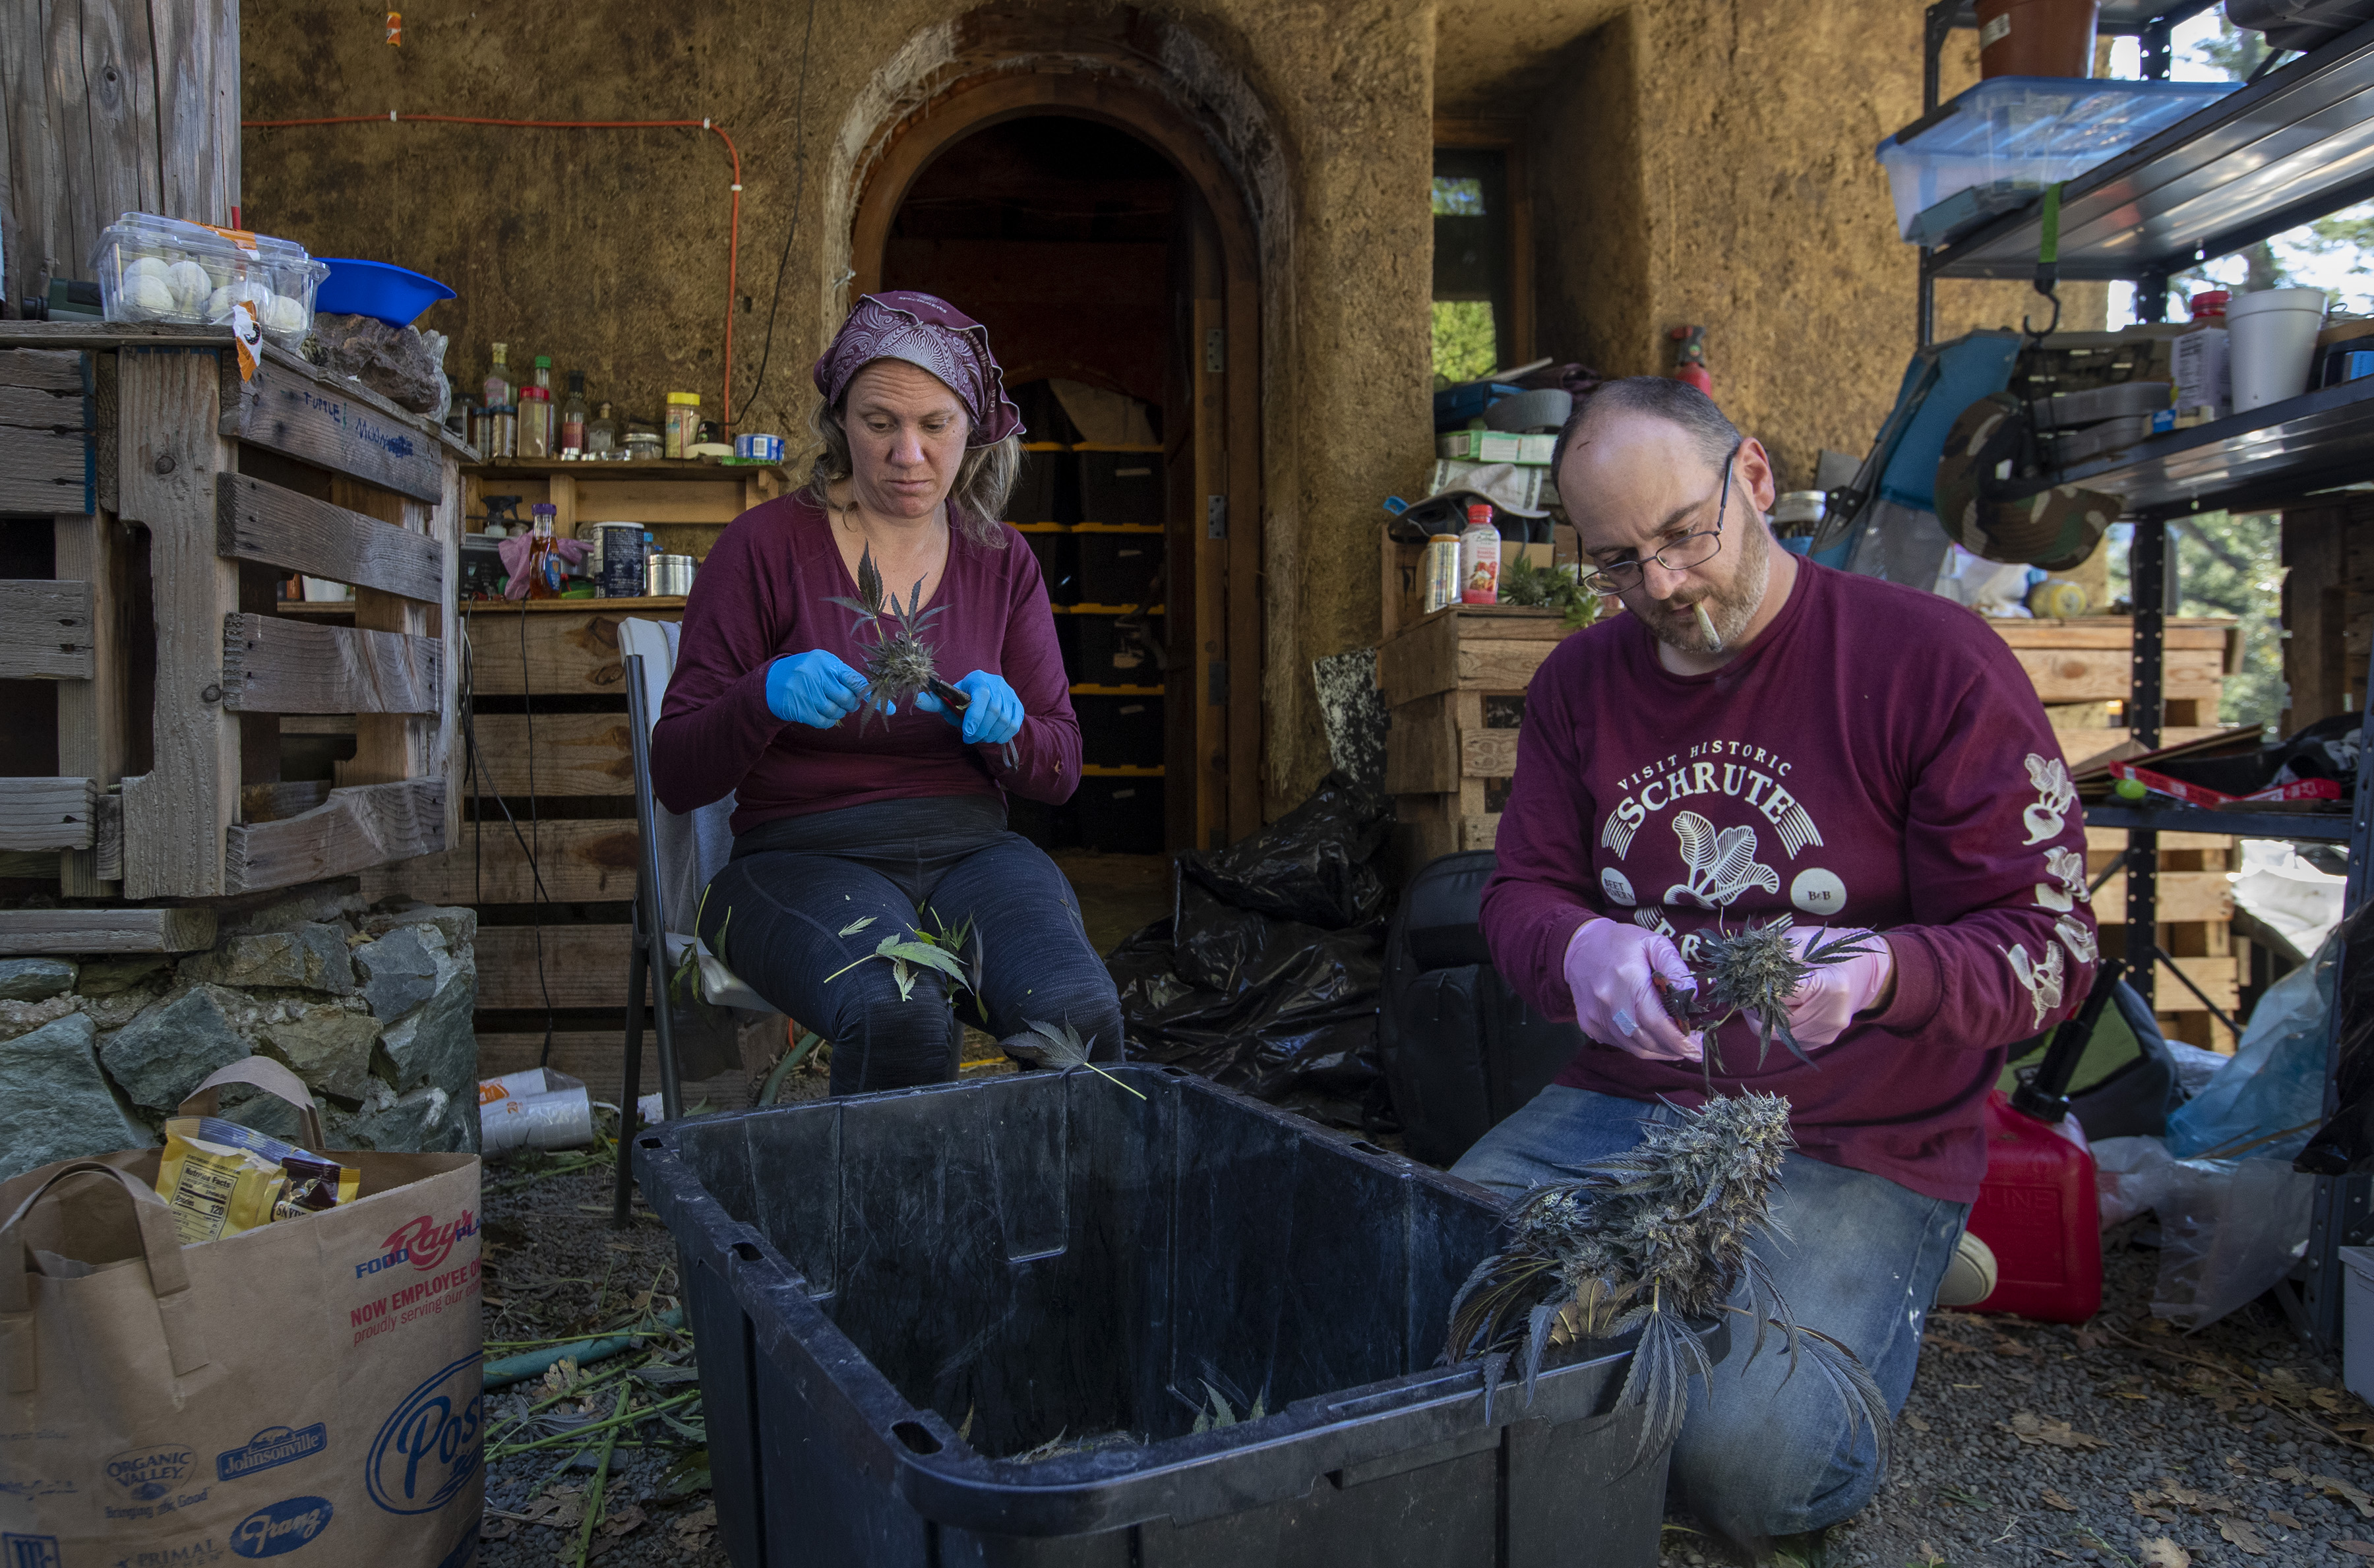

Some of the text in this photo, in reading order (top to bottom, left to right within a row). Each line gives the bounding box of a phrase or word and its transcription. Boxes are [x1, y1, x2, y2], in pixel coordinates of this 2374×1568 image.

[1618, 739, 1792, 791] VISIT HISTORIC
[1617, 762, 1796, 831] SCHRUTE
[1604, 878, 1624, 891] BEET
[185, 1166, 231, 1188] Nutrition Facts
[210, 1204, 225, 1216] 120
[379, 1209, 474, 1271] Ray's
[355, 1248, 410, 1279] FOOD
[350, 1297, 387, 1327] NOW
[392, 1265, 468, 1311] EMPLOYEE
[353, 1315, 397, 1348] proudly
[400, 1296, 442, 1324] serving
[444, 1289, 464, 1306] our
[107, 1451, 193, 1478] ORGANIC
[225, 1432, 320, 1474] Johnsonville
[137, 1538, 219, 1567] PRIMAL
[239, 1508, 322, 1555] Franz
